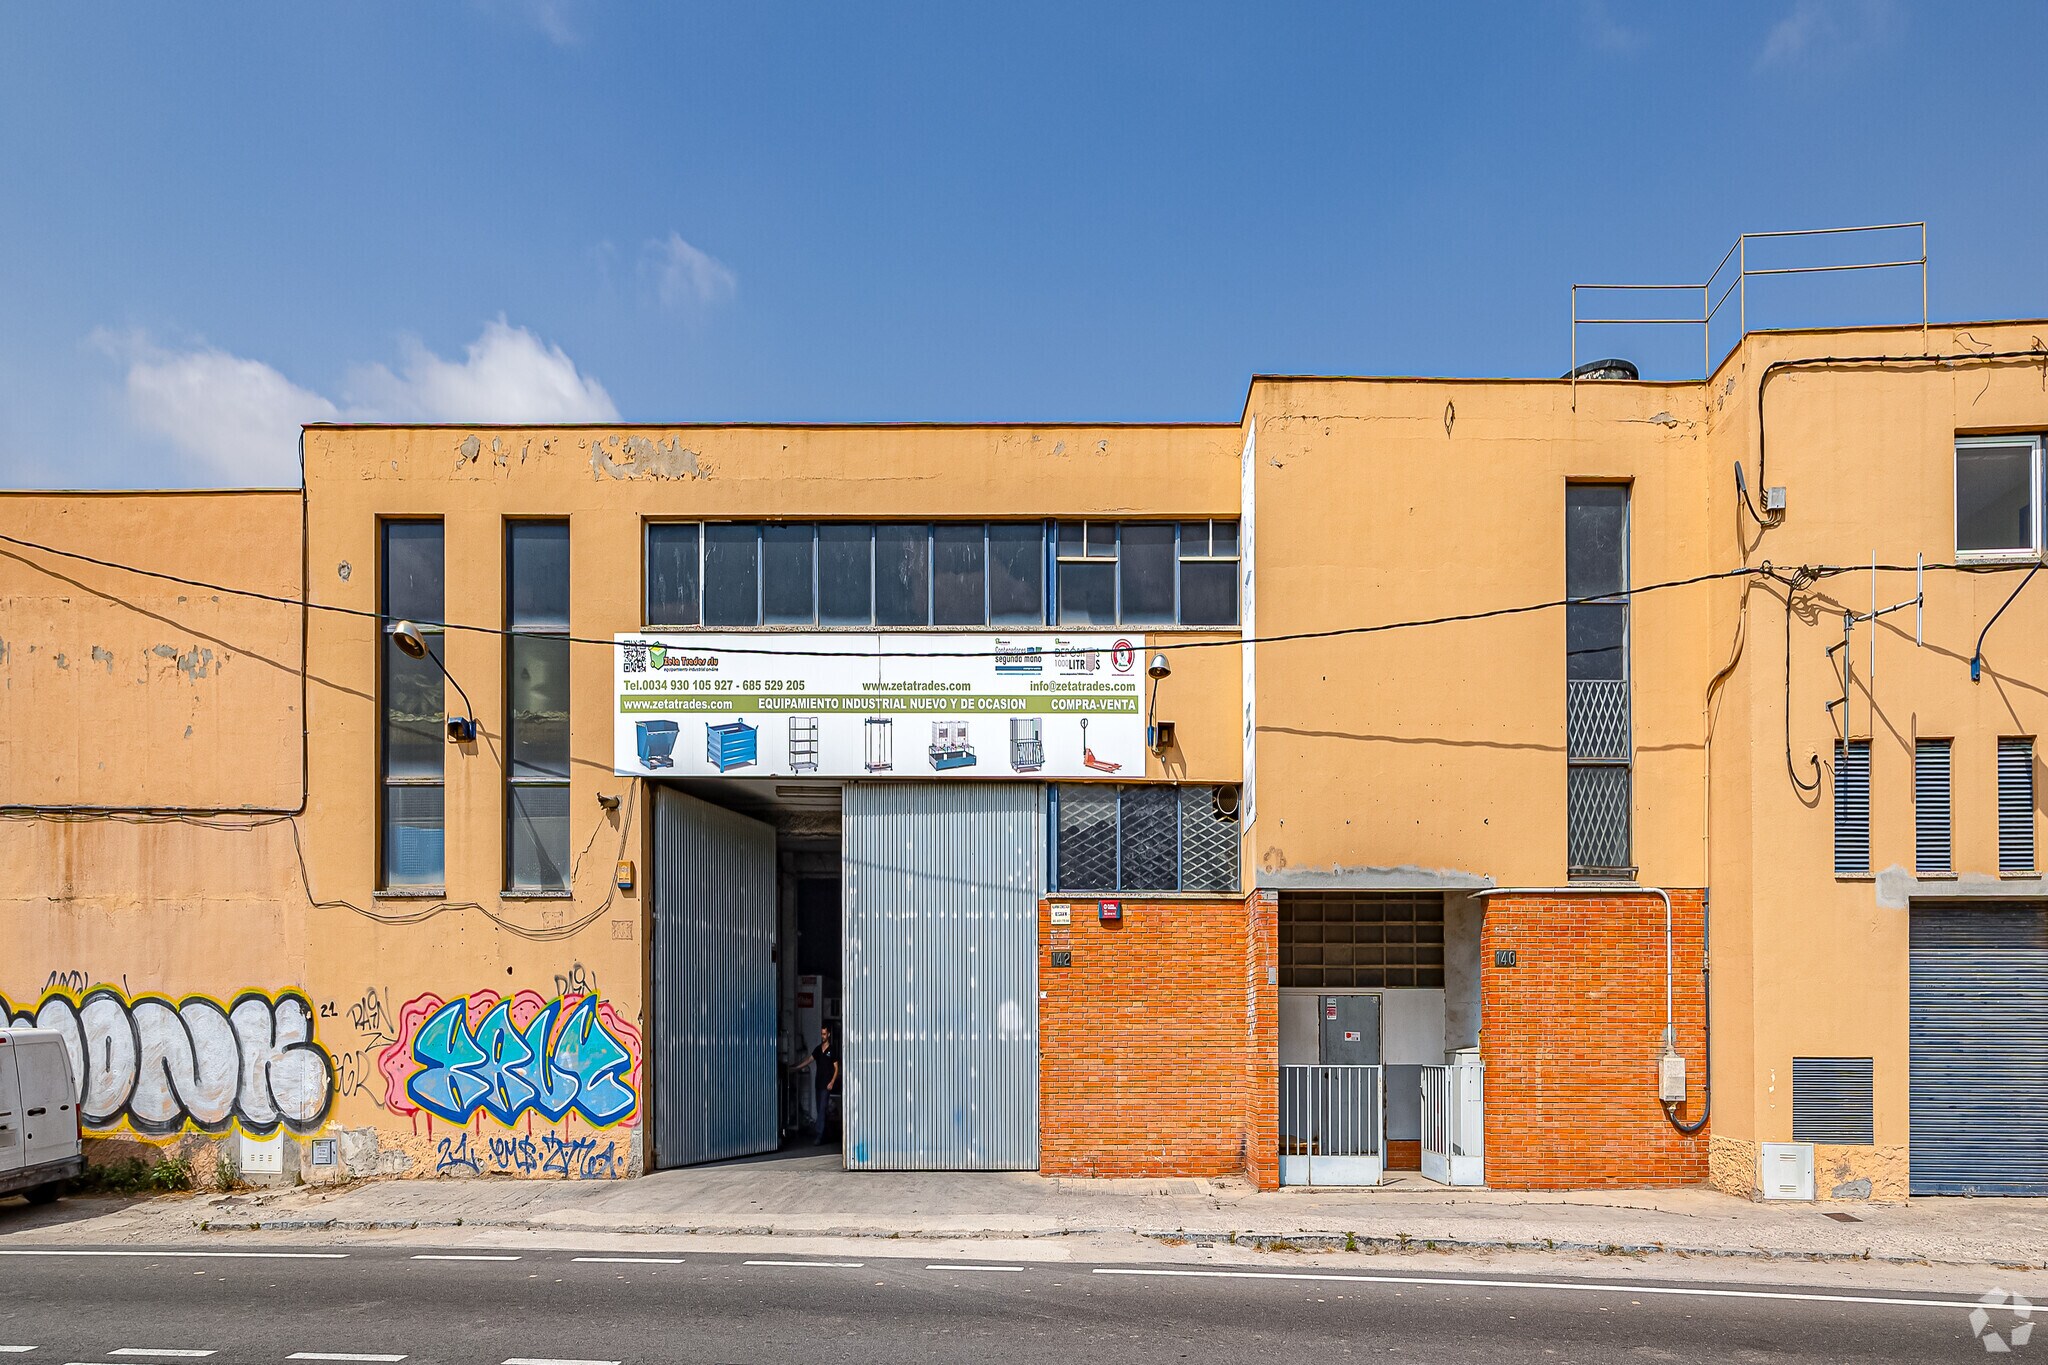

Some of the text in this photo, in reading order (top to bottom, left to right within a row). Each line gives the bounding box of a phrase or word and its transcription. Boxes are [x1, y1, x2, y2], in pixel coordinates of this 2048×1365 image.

[664, 657, 680, 666] Zeta
[681, 656, 706, 666] Trades
[995, 655, 1023, 665] segundo
[624, 679, 667, 691] Tel.0034
[671, 680, 690, 691] 930
[693, 680, 711, 691] 105
[715, 680, 733, 691] 927
[743, 680, 761, 691] 685
[765, 680, 783, 691] 529
[786, 680, 805, 691] 205
[862, 680, 971, 691] www.zetatrades.com
[1030, 680, 1136, 692] info@zetatrades.com
[624, 698, 733, 710] www.zetatrades.com
[758, 698, 1026, 710] EQUIPAMIENTO INDUSTRIAL NUEVO Y DE OCASION
[1051, 698, 1136, 710] COMPRA-VENTA
[1052, 952, 1070, 966] 142
[1495, 951, 1516, 966] 140
[320, 1001, 338, 1018] 21
[0, 988, 333, 1138] ONK
